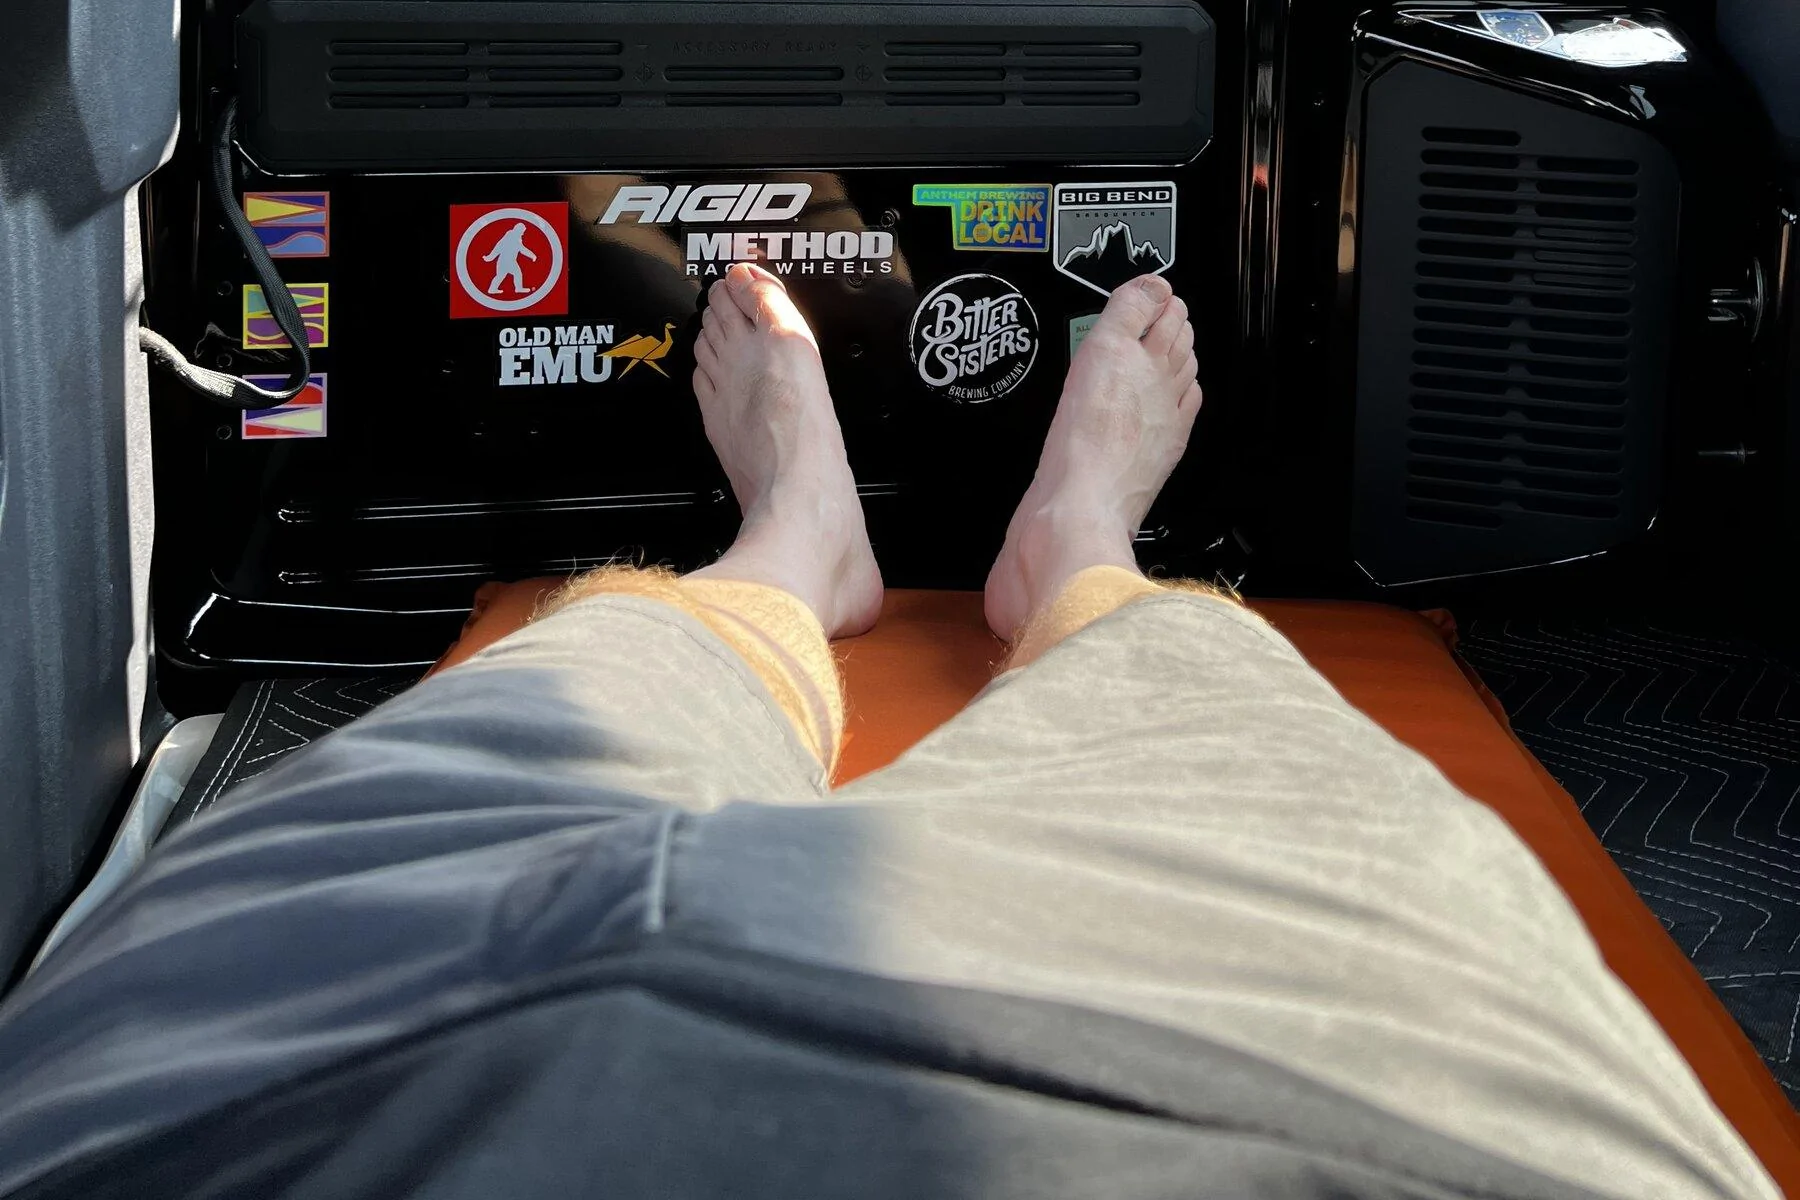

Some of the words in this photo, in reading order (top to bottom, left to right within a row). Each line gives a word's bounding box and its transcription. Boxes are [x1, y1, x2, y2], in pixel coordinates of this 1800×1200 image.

[600, 183, 813, 224] RIGID
[920, 190, 978, 200] ANTHEM
[979, 190, 1045, 200] BREWING
[1061, 191, 1100, 203] BIG
[1106, 190, 1170, 202] BEND
[960, 200, 1043, 221] DRINK
[960, 222, 1043, 244] LOCAL
[686, 231, 893, 261] METHOD
[686, 263, 757, 276] RAC
[776, 261, 892, 274] WHEELS
[499, 327, 551, 348] OLD
[555, 325, 615, 346] MAN
[499, 345, 614, 386] EMU
[948, 385, 989, 399] BREWING
[991, 361, 1026, 394] COMPANY
